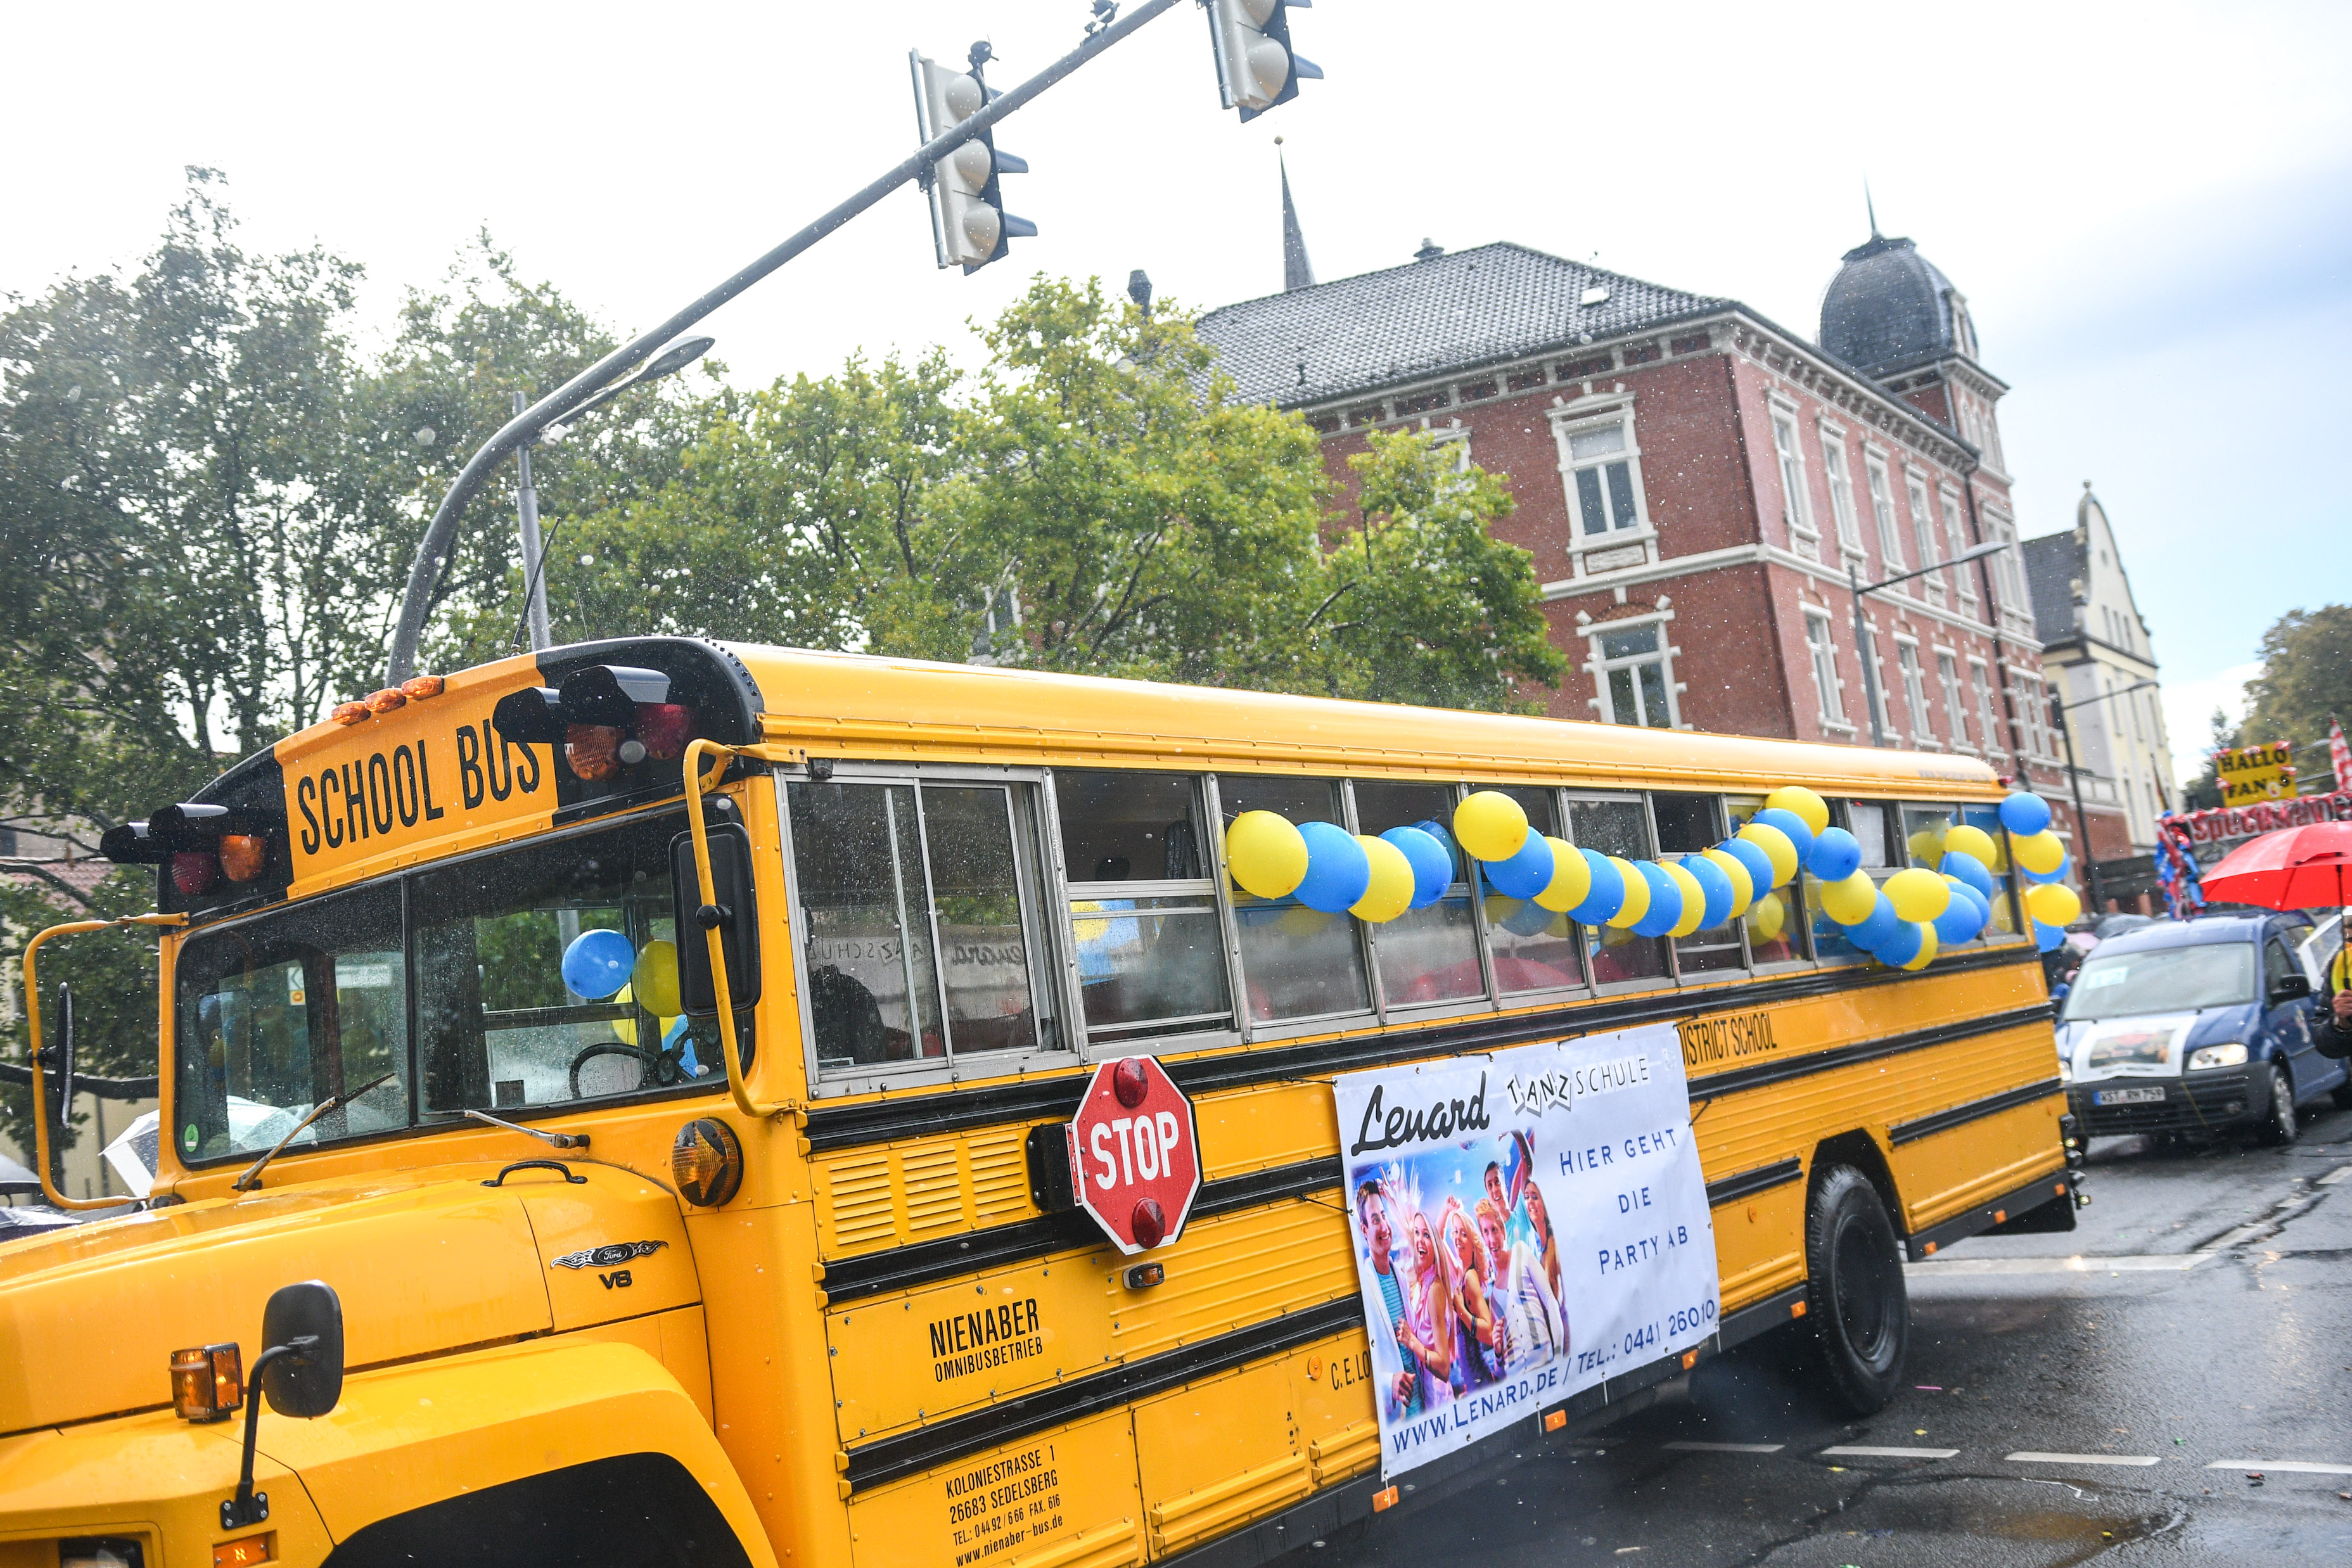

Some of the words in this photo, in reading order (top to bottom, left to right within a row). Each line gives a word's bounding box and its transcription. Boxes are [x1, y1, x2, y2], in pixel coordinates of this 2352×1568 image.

[2221, 749, 2287, 772] HALLO
[297, 739, 444, 855] SCHOOL
[456, 718, 540, 810] BUS
[1730, 1012, 1777, 1056] SCHOOL
[1351, 1071, 1490, 1157] Lenard
[1090, 1111, 1179, 1190] STOP
[1624, 1128, 1676, 1158] GEHT
[1618, 1187, 1651, 1214] DIE
[604, 1249, 623, 1261] Ford
[1668, 1225, 1688, 1249] AB
[598, 1270, 632, 1290] V8
[929, 1297, 1039, 1359] NIENABER
[1624, 1321, 1661, 1354] 0441
[1668, 1299, 1715, 1337] 26010
[935, 1336, 1044, 1382] OMNIBUSBETRIEB
[945, 1449, 1042, 1500] KOLONIESTRASSE
[1049, 1445, 1055, 1461] 1
[950, 1495, 987, 1524] 26683
[990, 1469, 1058, 1509] SEDELSBERG
[1029, 1500, 1046, 1517] FAX.
[1048, 1493, 1061, 1509] 616
[955, 1514, 1063, 1568] www.nienaber-bus.de
